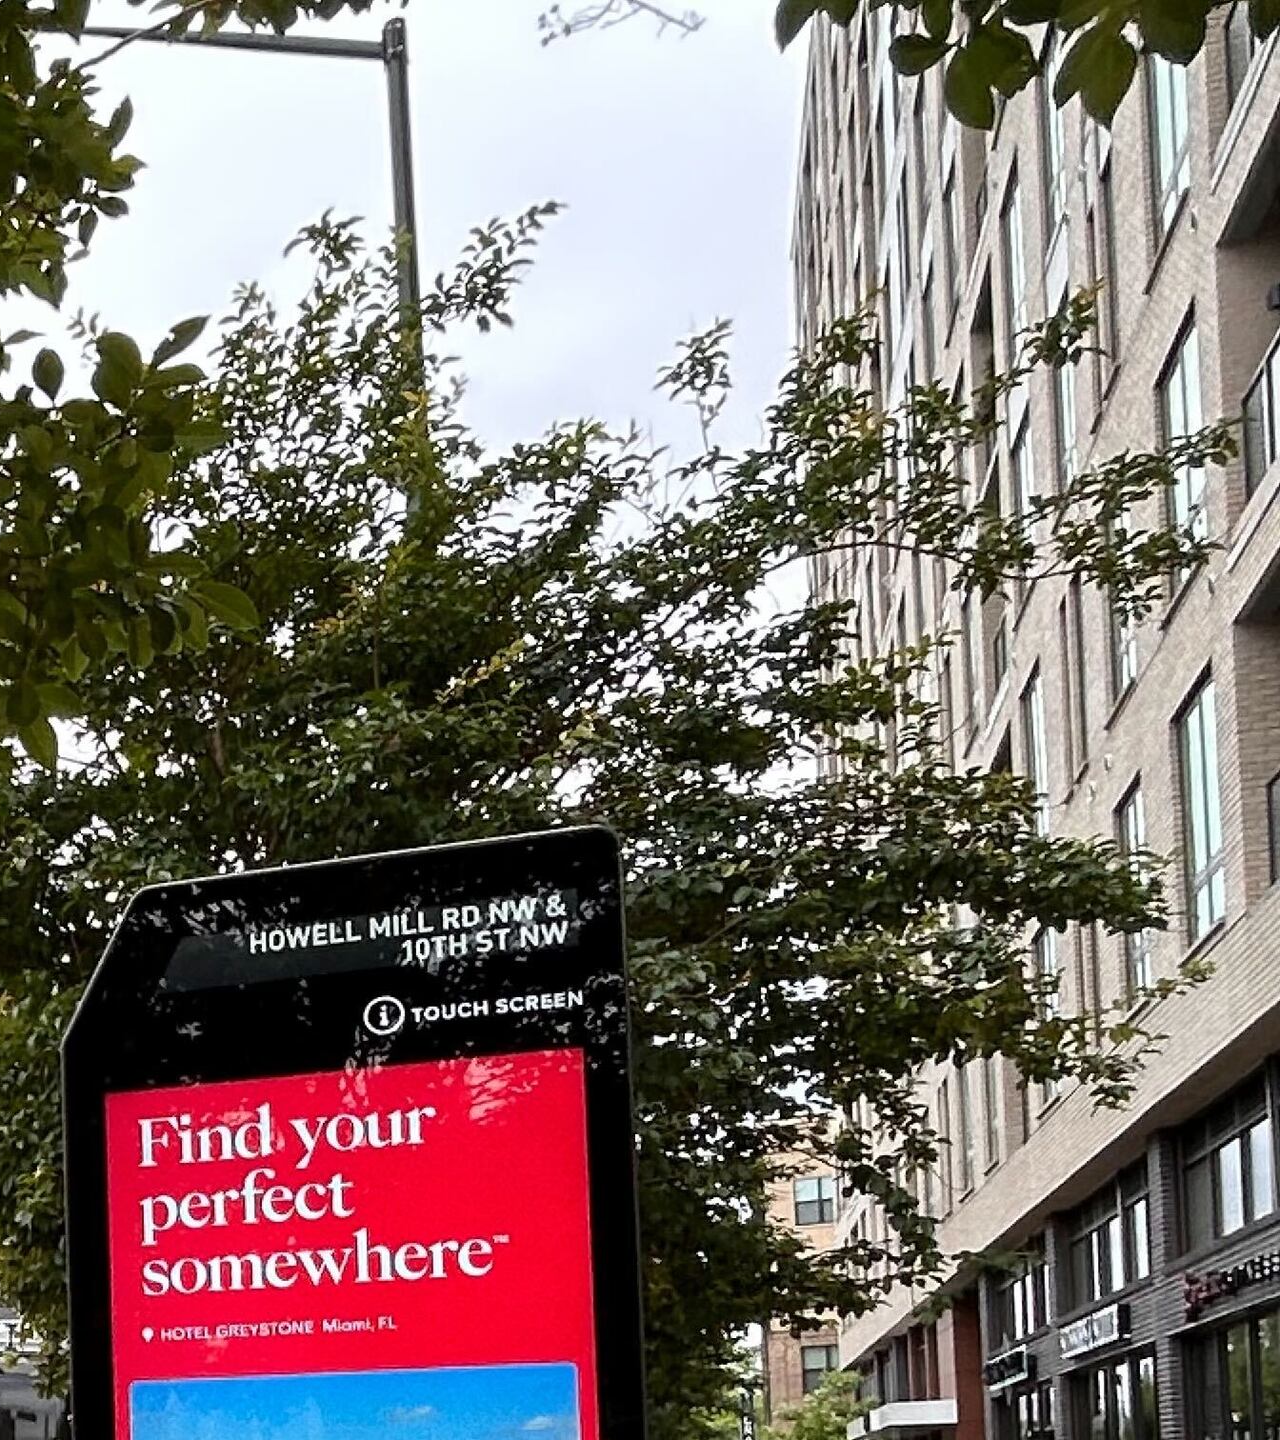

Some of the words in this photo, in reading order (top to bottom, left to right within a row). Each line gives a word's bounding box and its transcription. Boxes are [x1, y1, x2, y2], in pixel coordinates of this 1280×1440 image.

[250, 919, 362, 954] HOWELL
[369, 910, 435, 939] MILL
[442, 905, 480, 931] RD
[490, 896, 538, 925] NW
[545, 893, 567, 918] &
[401, 932, 468, 963] 10TH
[476, 927, 511, 952] ST
[519, 920, 569, 948] NW
[410, 1000, 490, 1024] TOUCH
[495, 989, 584, 1015] SCREEN
[137, 1101, 274, 1168] Find
[289, 1106, 437, 1170] your
[139, 1167, 355, 1247] perfect
[160, 1326, 212, 1343] HOTEL
[216, 1319, 314, 1339] GREYSTONE
